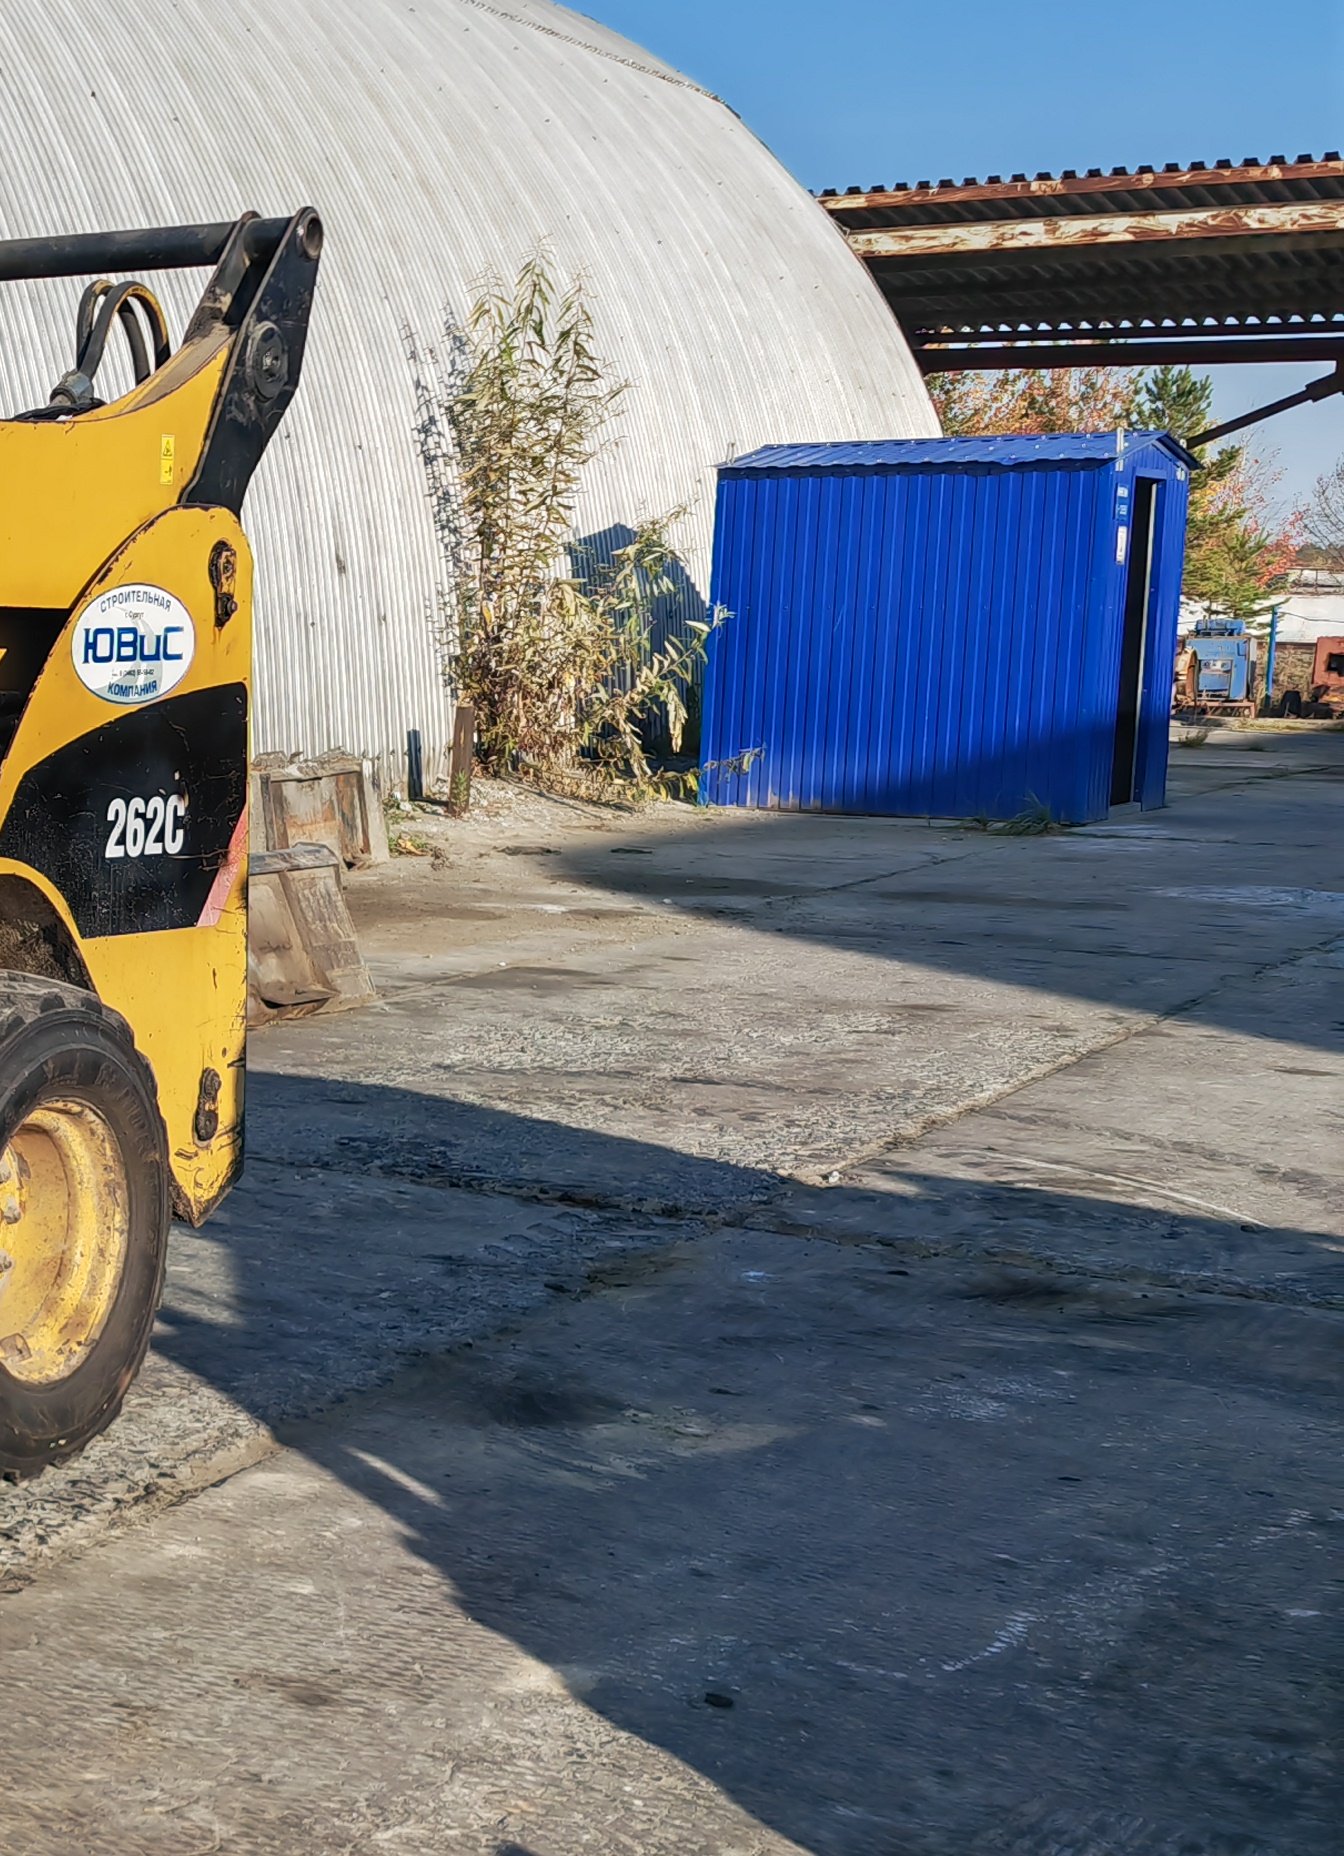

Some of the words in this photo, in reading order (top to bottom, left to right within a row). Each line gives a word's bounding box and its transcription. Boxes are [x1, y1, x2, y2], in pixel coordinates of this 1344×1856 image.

[100, 590, 171, 613] СТРОИТЕЛЬНАЯ
[107, 680, 157, 697] КОМПАНИЯ
[105, 794, 185, 858] 262C
